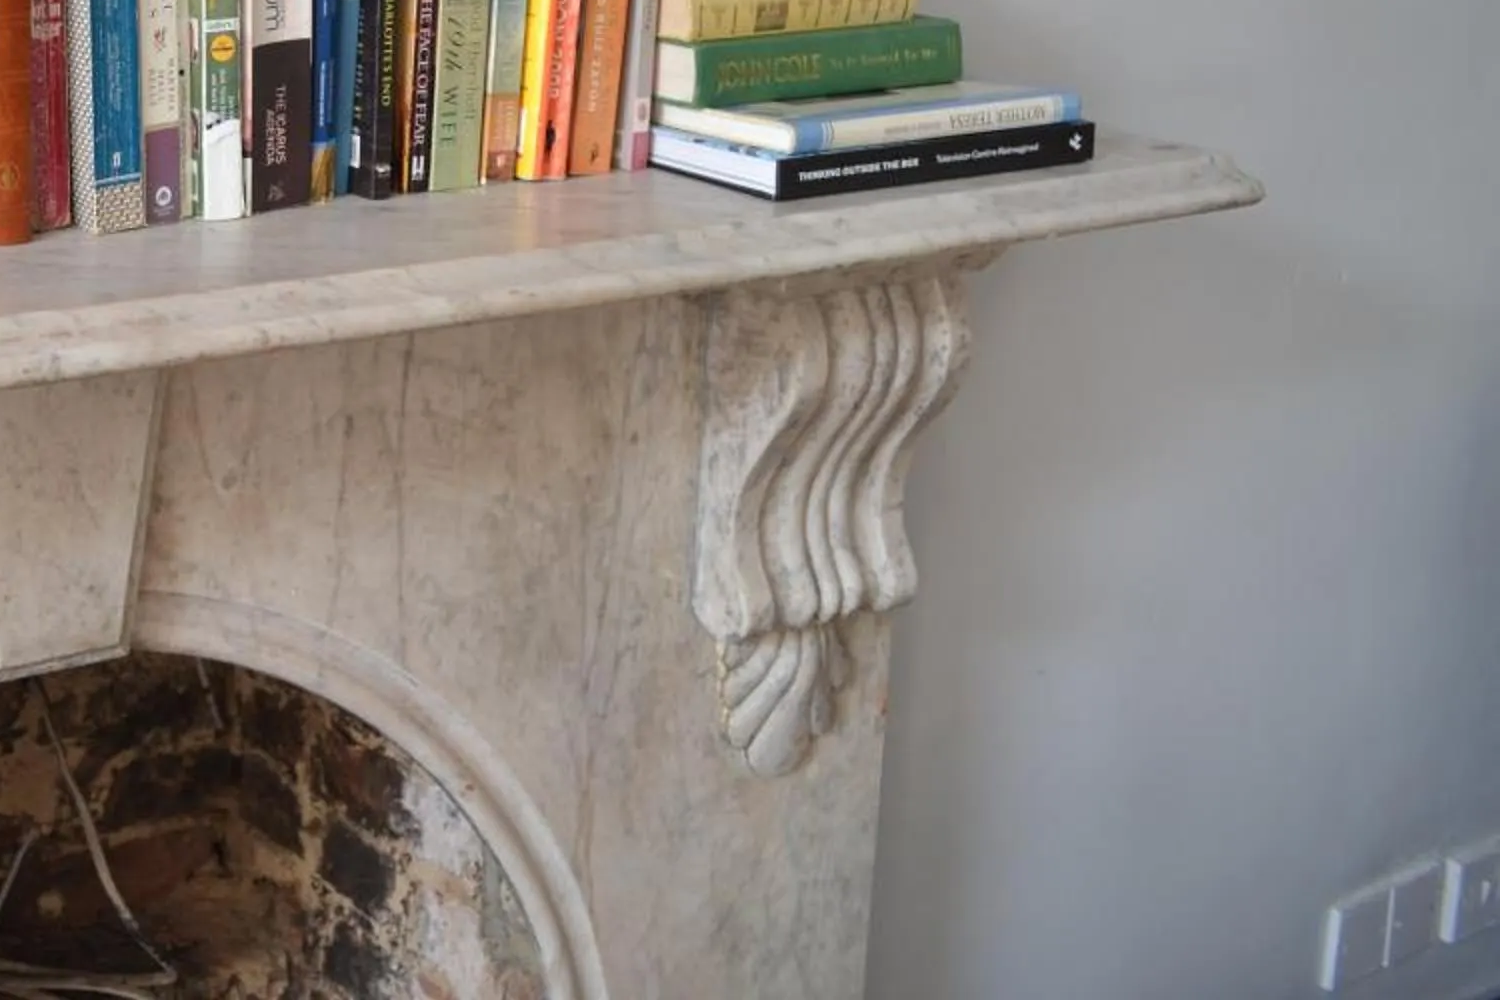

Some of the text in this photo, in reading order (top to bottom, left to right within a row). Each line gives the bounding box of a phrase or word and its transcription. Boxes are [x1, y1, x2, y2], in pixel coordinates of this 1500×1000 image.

[418, 28, 432, 71] FACE
[445, 16, 466, 72] 19th
[416, 73, 430, 100] OF
[715, 58, 772, 93] JOHN
[774, 53, 822, 82] COLE
[275, 84, 288, 112] THE
[440, 86, 460, 146] WIFE
[995, 104, 1047, 124] MOTHER
[265, 108, 277, 167] AGENDA
[413, 103, 427, 146] FEAR
[950, 109, 992, 130] TERESA
[881, 159, 900, 172] THE
